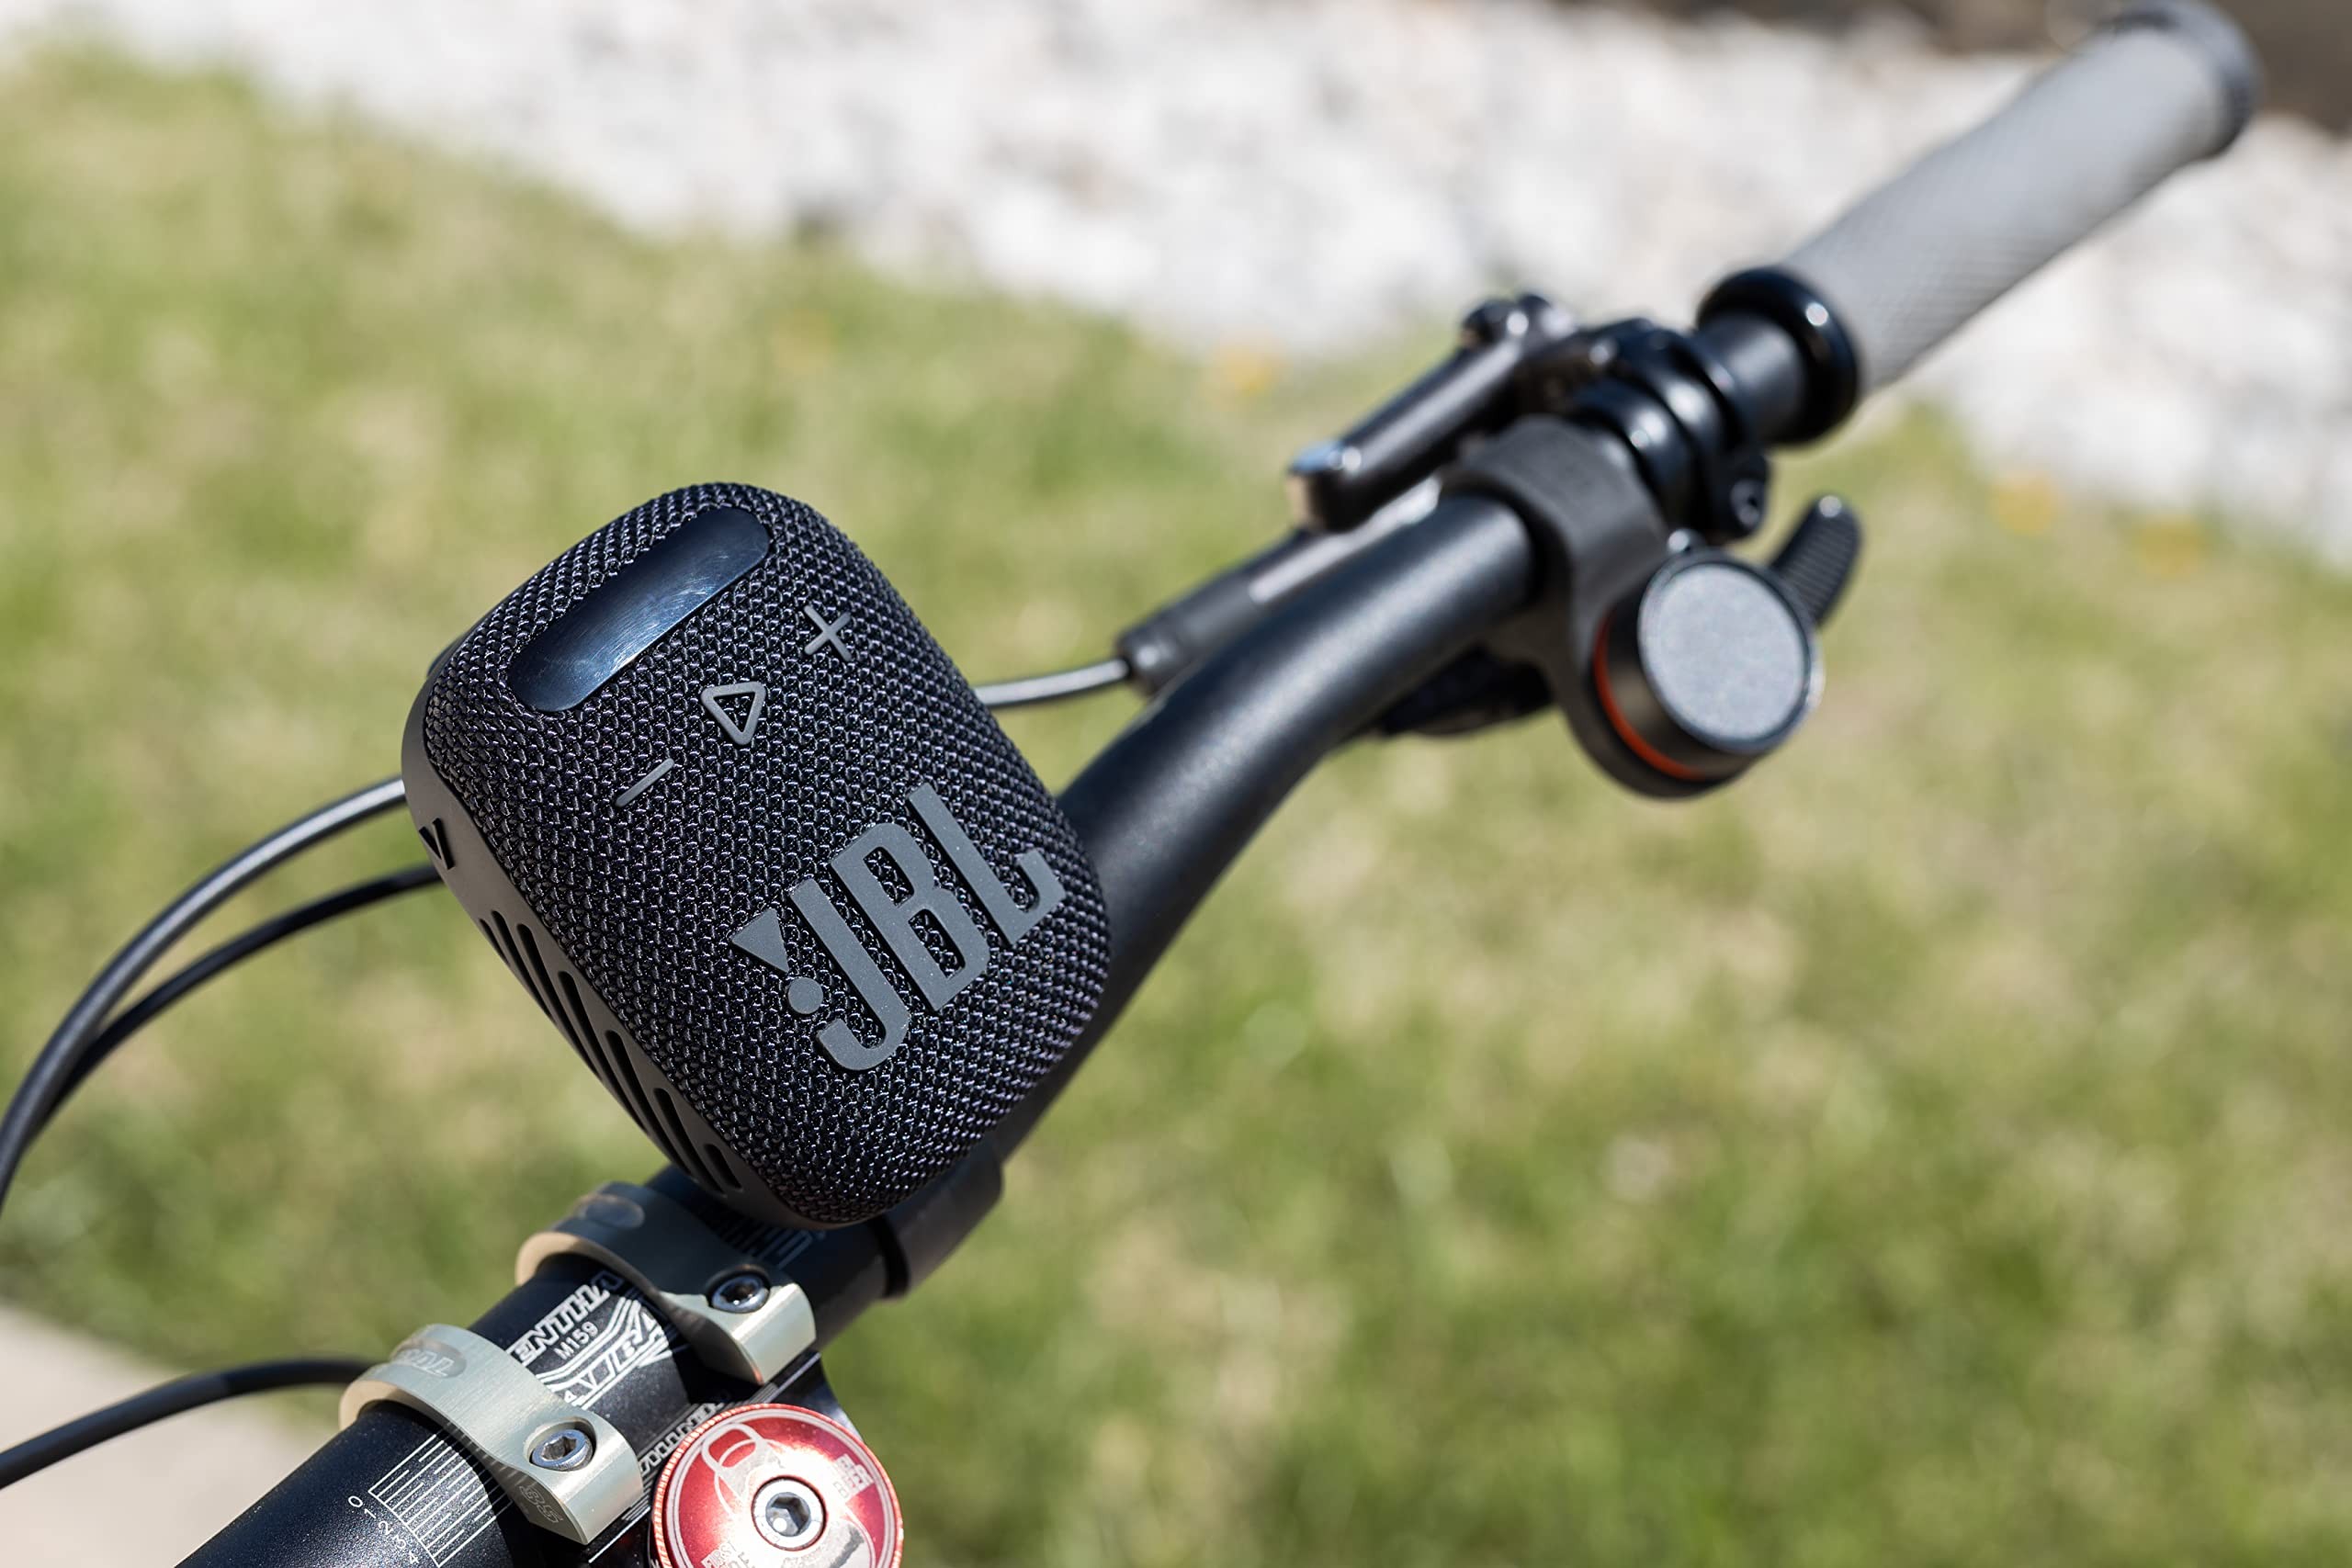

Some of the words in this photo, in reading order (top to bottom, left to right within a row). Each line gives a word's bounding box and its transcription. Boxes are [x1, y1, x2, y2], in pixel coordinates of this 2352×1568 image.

[787, 784, 1067, 1072] JBL
[553, 1321, 598, 1360] M159
[348, 1495, 364, 1508] 0
[364, 1508, 377, 1519] 1
[379, 1520, 394, 1536] 2
[392, 1534, 407, 1550] 3
[409, 1551, 420, 1564] 4
